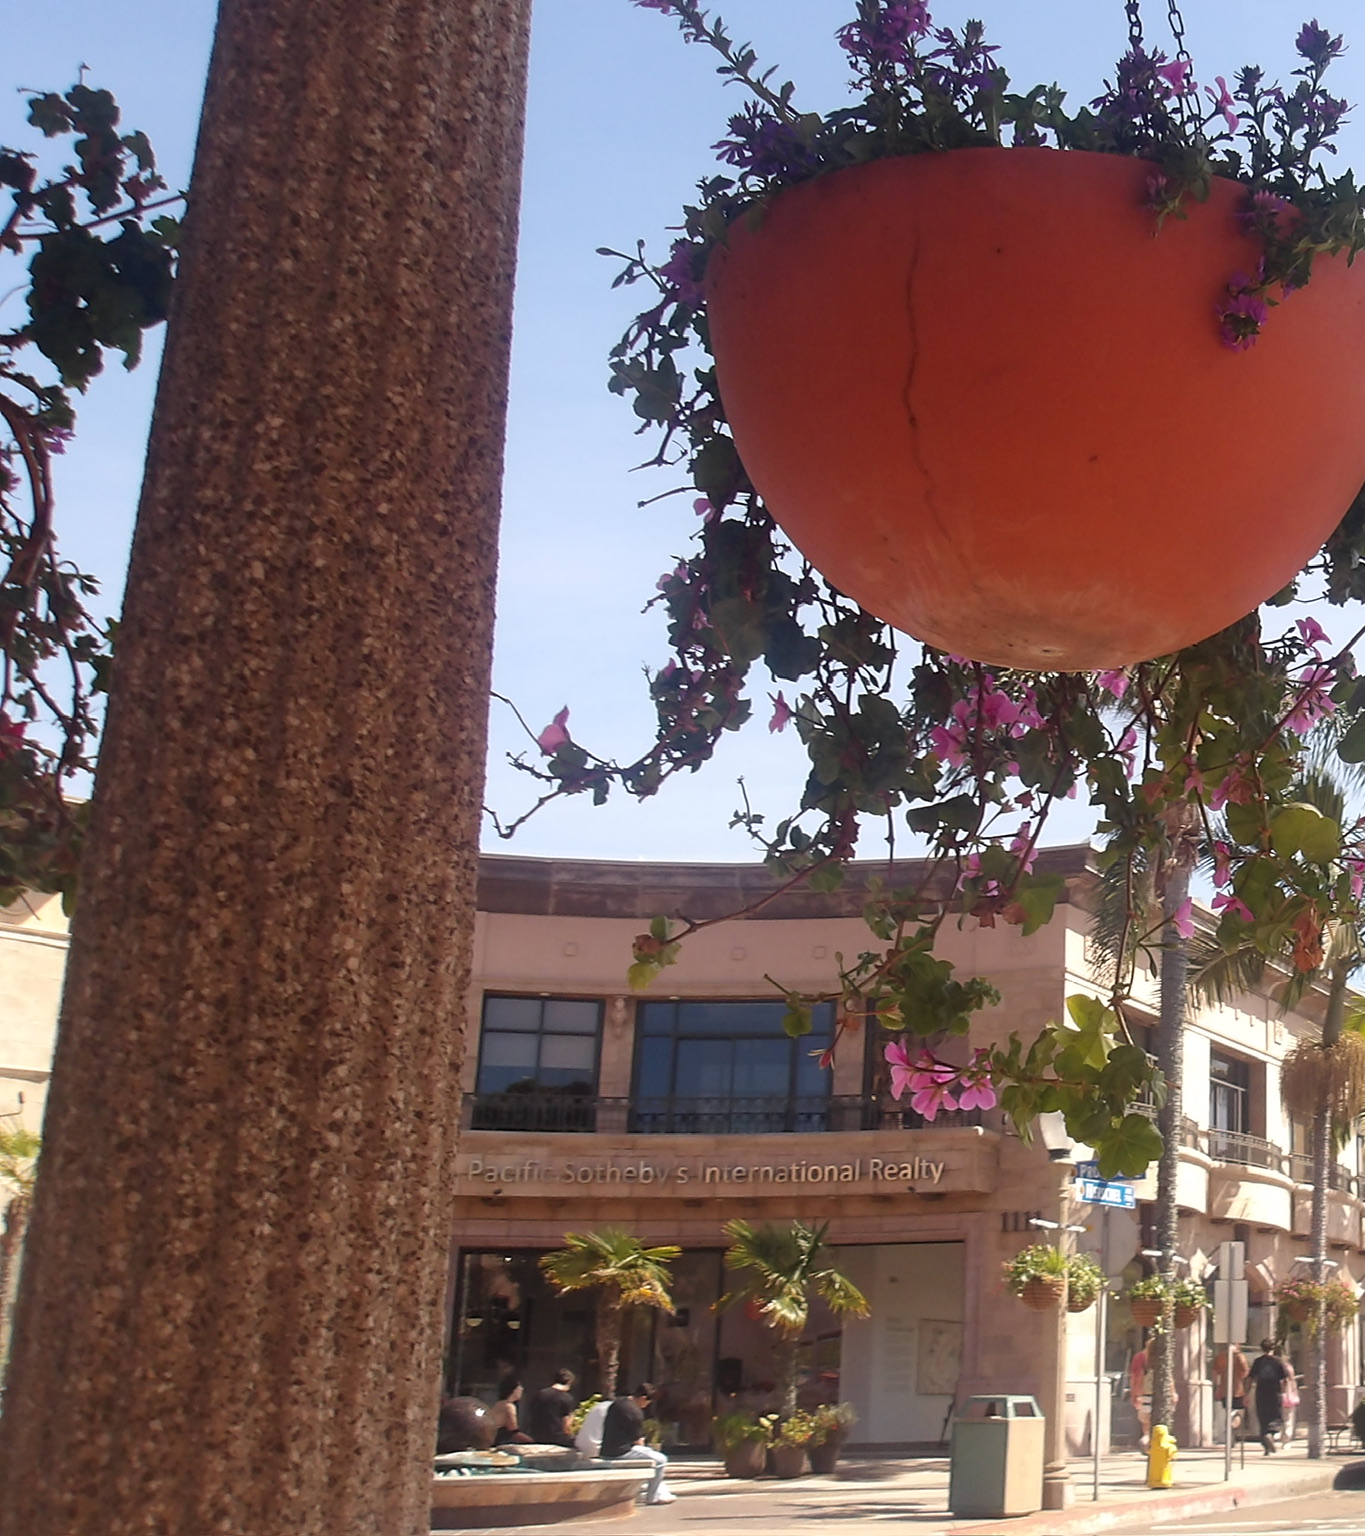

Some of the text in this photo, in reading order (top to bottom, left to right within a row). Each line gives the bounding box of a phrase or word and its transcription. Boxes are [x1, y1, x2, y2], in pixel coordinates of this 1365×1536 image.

[467, 1156, 944, 1187] Pacific Sotheby's International Realty
